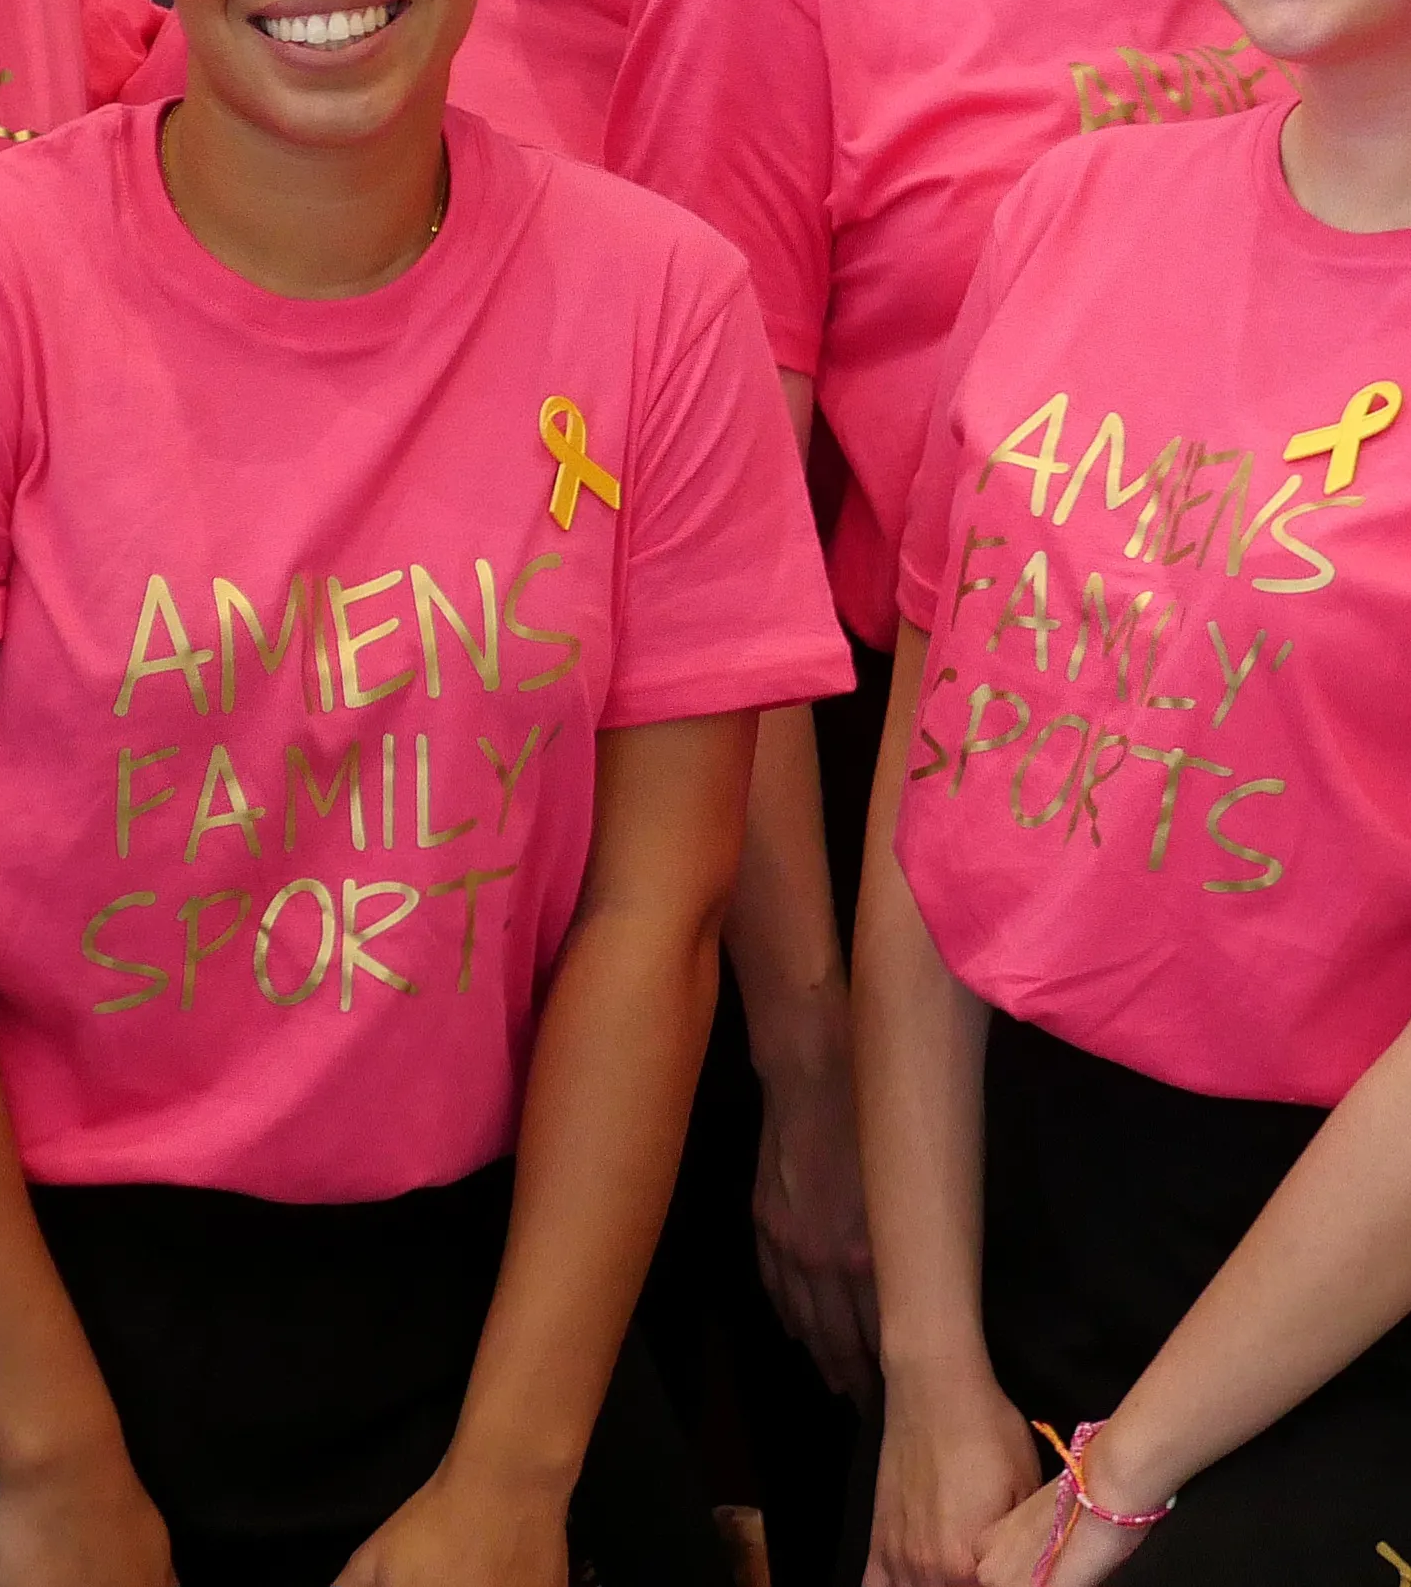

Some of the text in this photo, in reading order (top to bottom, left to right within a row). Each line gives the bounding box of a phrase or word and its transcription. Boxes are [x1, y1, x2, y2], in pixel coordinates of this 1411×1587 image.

[975, 392, 1366, 594] AMIENS
[113, 552, 581, 717] AMIENS
[81, 863, 518, 1014] SPORT
